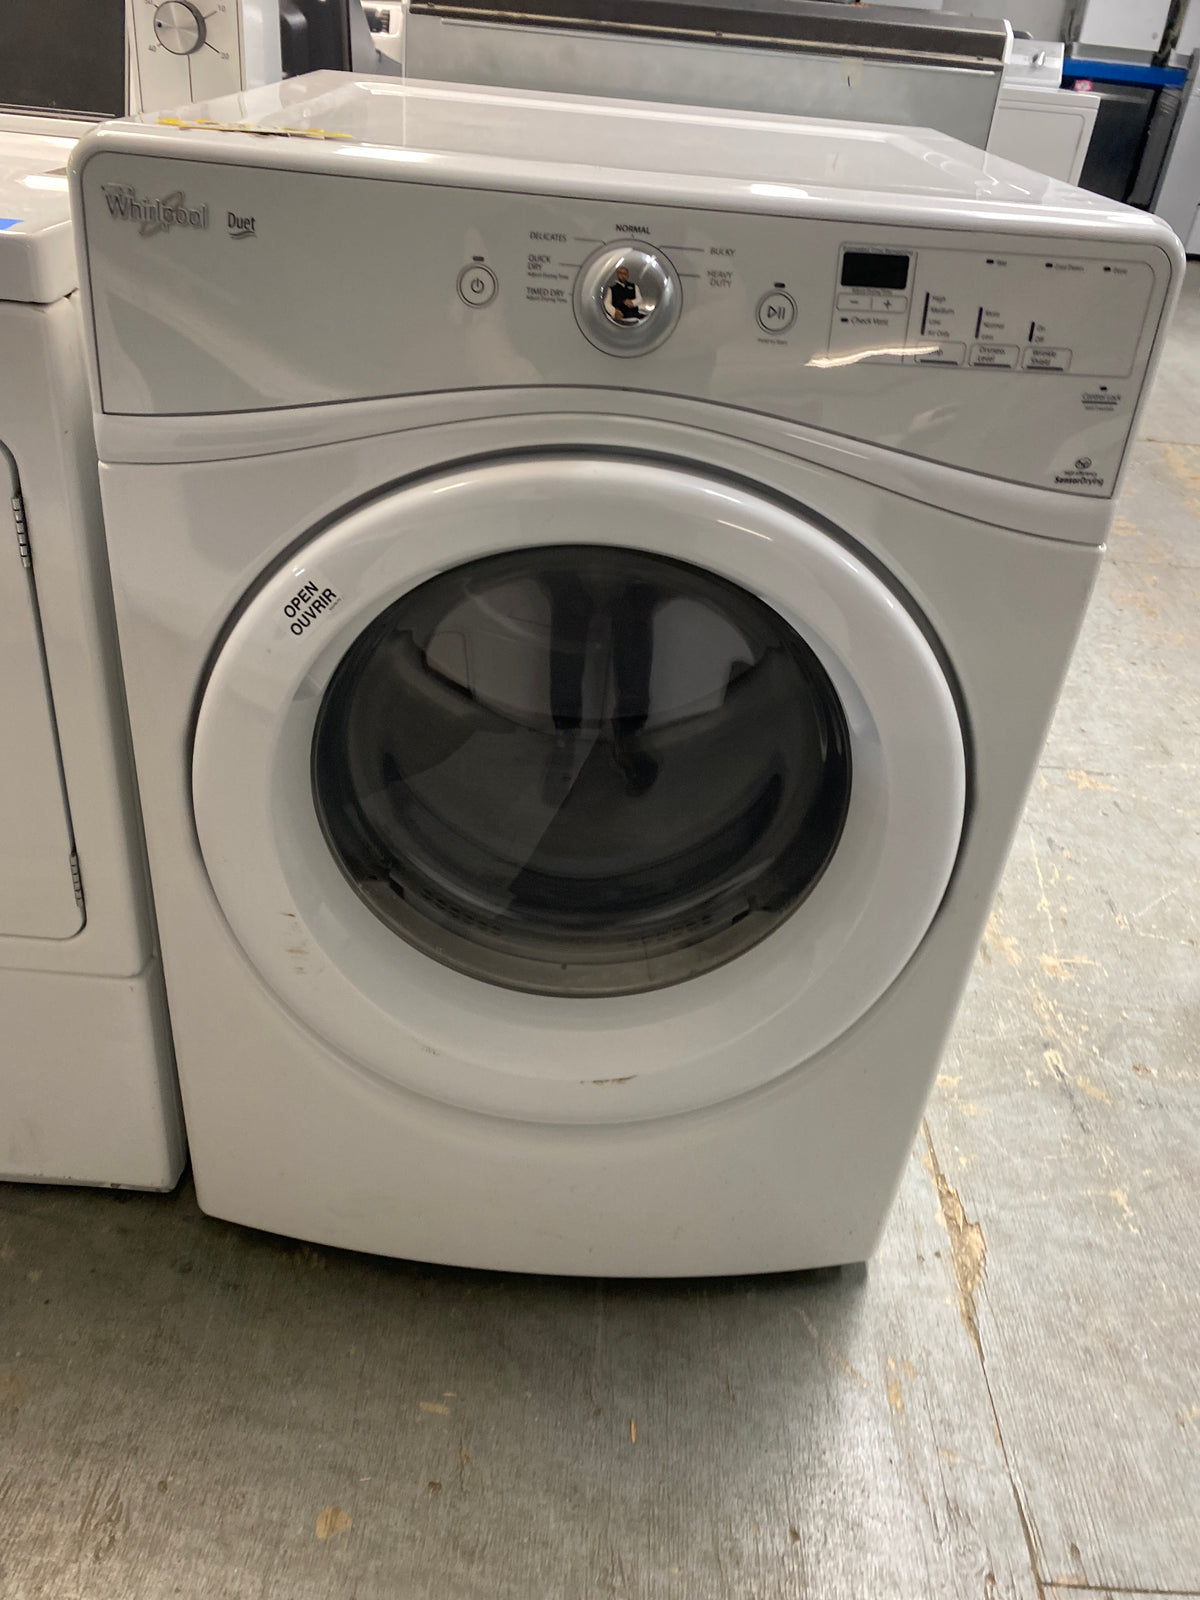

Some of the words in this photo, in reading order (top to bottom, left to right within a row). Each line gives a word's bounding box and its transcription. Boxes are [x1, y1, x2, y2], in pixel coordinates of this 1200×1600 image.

[100, 182, 209, 230] Whirlpool
[227, 211, 256, 233] Duet
[615, 224, 651, 235] NORMAL
[528, 231, 567, 242] DELICATES
[710, 246, 736, 256] BULKY
[528, 253, 551, 263] QUICK
[528, 262, 542, 271] DRY
[706, 269, 733, 279] HEAVY
[709, 277, 733, 288] DUTY
[525, 286, 549, 296] TIMED
[550, 288, 565, 297] DRY
[284, 580, 319, 618] OPEN
[290, 588, 337, 636] OUVRIR
